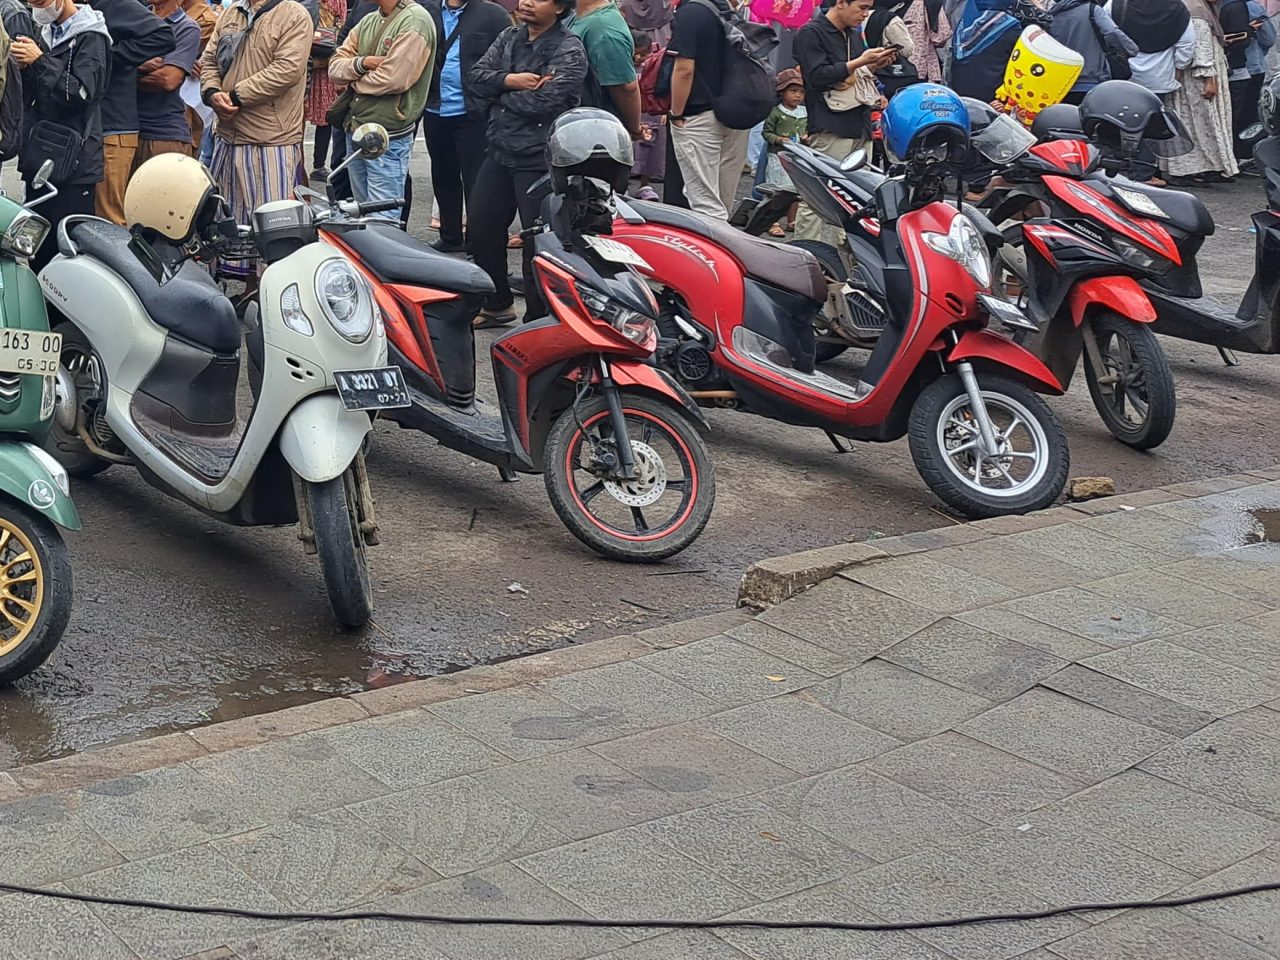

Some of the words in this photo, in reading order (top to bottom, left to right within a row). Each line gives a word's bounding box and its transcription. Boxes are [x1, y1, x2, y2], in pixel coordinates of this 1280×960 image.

[1073, 222, 1103, 241] HONDA
[42, 273, 68, 302] SCOOPY
[340, 375, 350, 391] A
